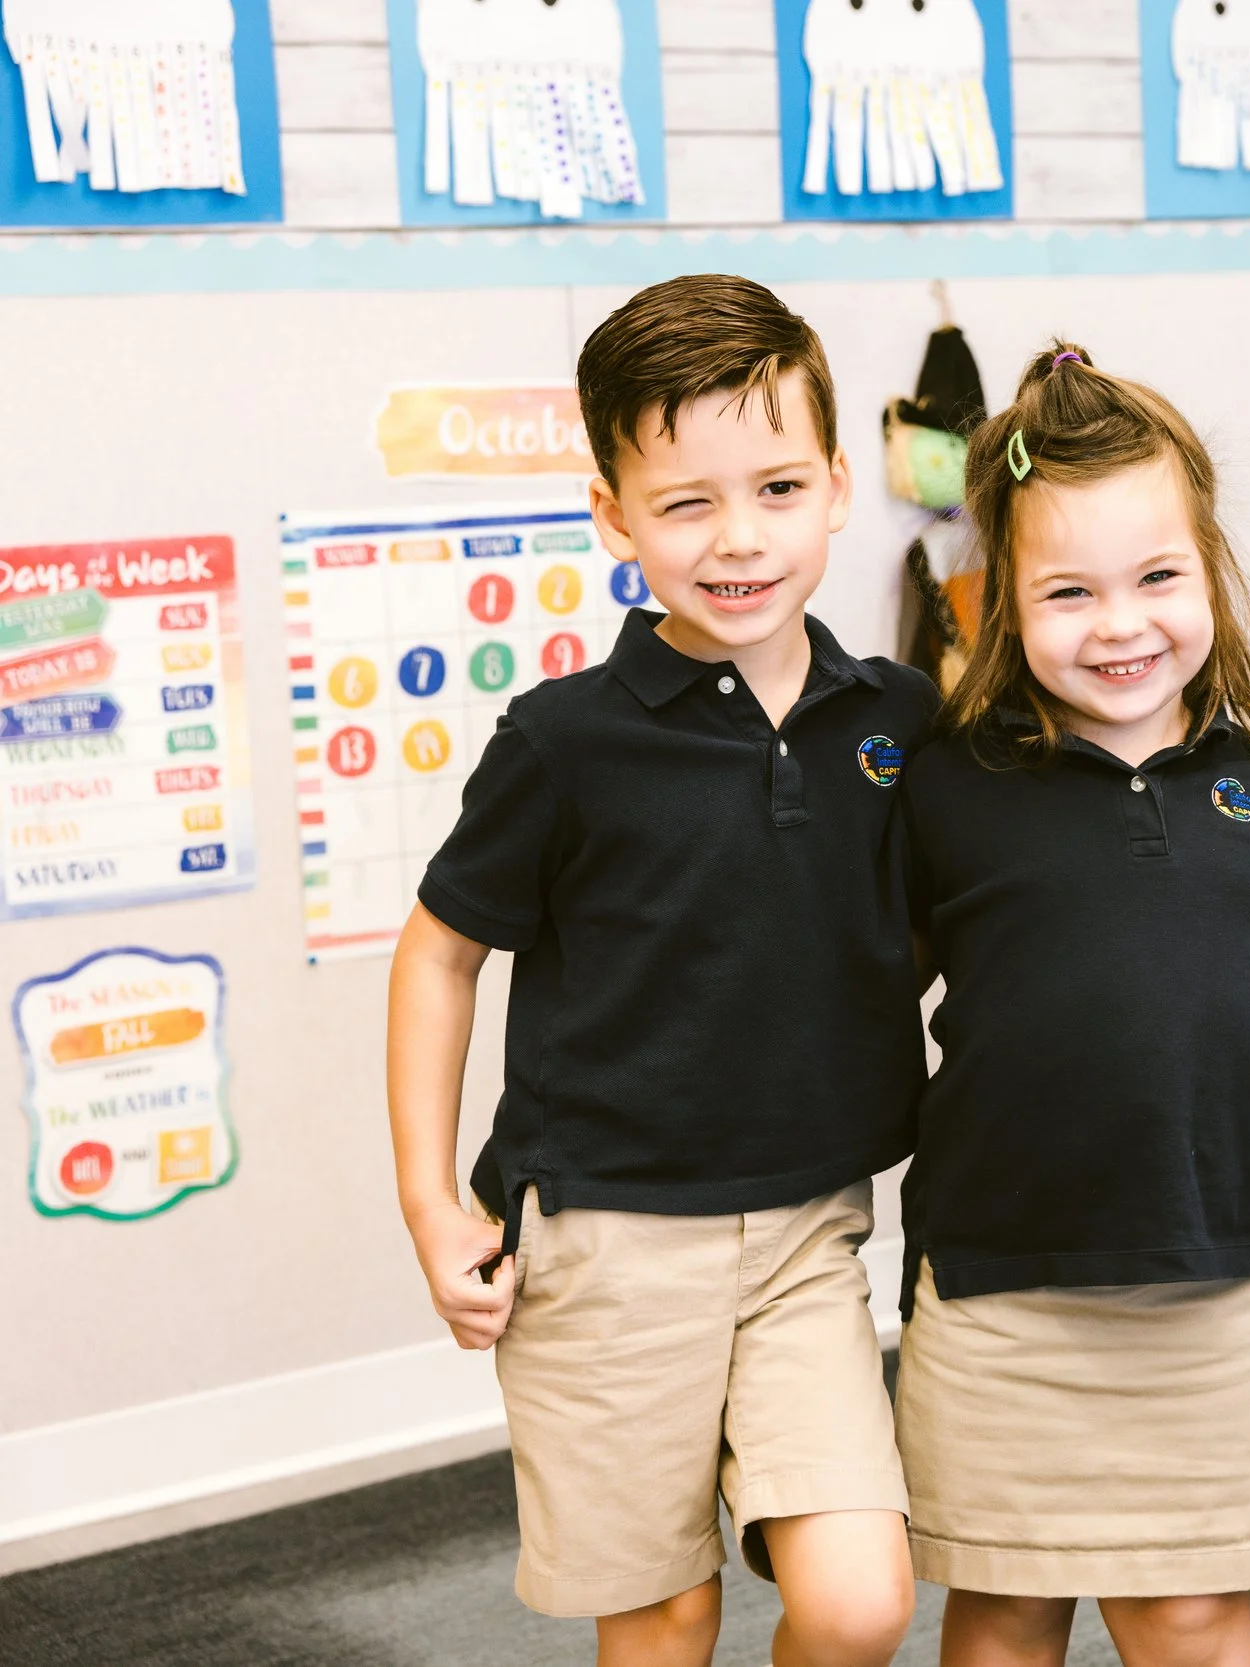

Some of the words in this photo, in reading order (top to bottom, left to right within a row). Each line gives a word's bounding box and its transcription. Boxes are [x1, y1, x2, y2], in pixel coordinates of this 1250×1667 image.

[438, 404, 590, 457] Octobe
[0, 559, 80, 595] Days
[118, 545, 214, 587] Week
[622, 563, 641, 600] 3
[485, 581, 497, 617] 1
[552, 571, 568, 608] 2
[0, 595, 90, 628] ESTERDAY
[5, 654, 69, 690] TODAY
[74, 649, 98, 673] IS
[412, 652, 433, 691] 7
[483, 647, 506, 685] 8
[553, 637, 573, 677] 9
[343, 665, 364, 701] 6
[339, 730, 368, 771] 13
[102, 1019, 156, 1052] FALL
